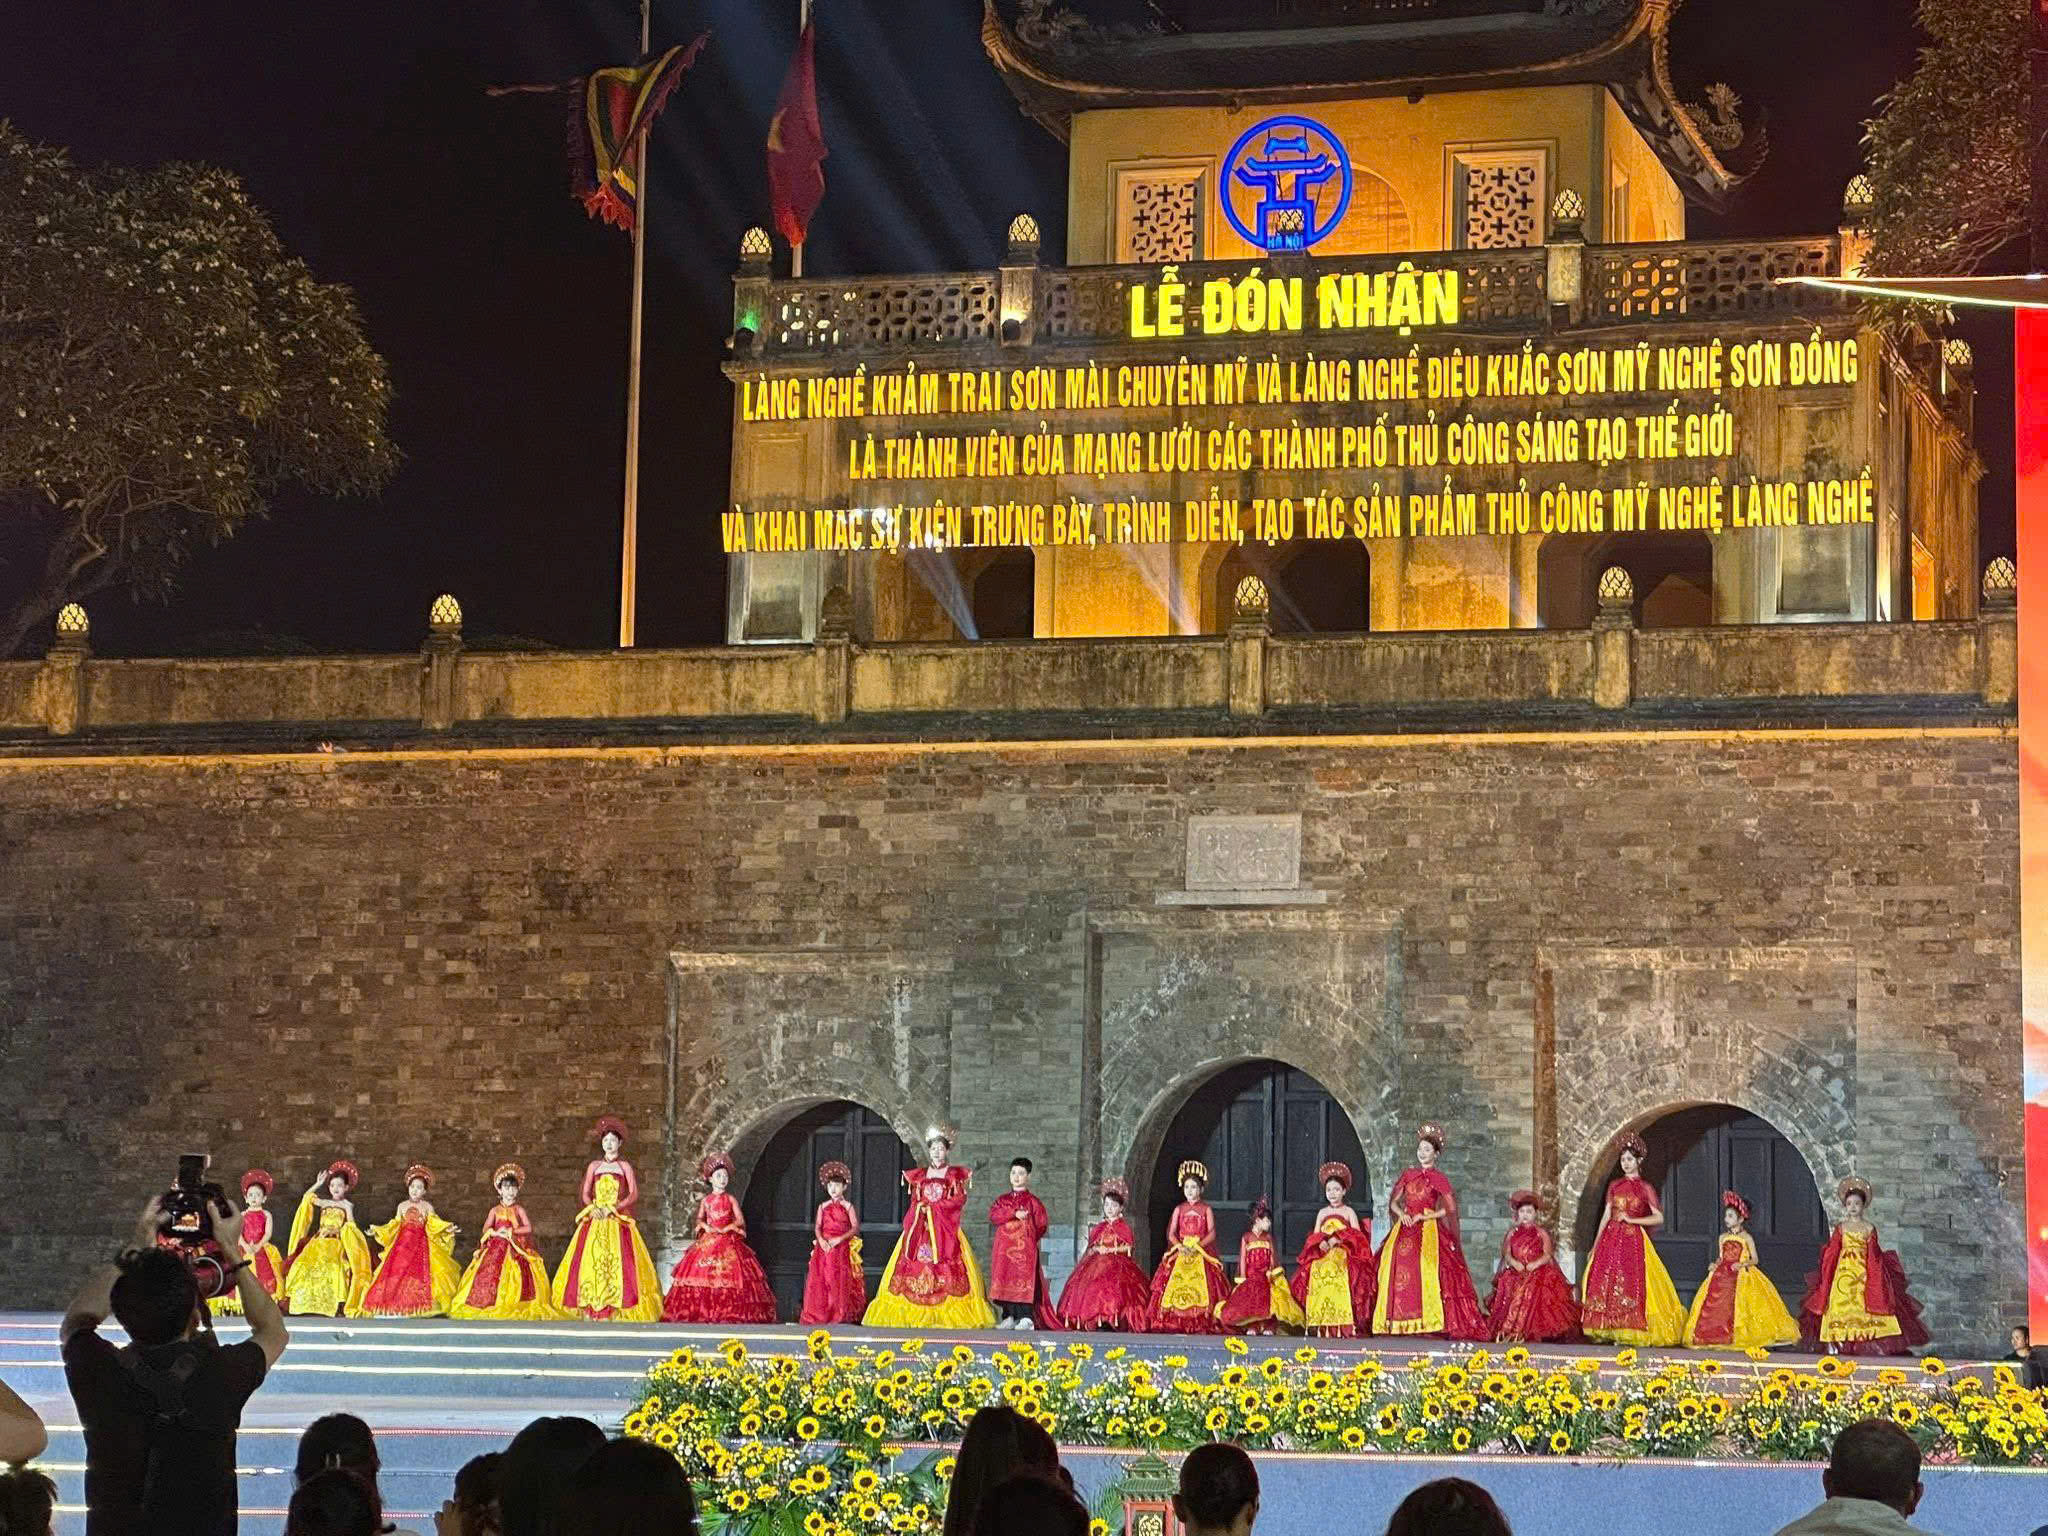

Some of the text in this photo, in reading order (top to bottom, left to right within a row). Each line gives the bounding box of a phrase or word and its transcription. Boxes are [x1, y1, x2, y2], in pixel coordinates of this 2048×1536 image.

[1267, 232, 1282, 249] HÀ
[1132, 262, 1458, 338] LỄ ĐÓN NHẬN
[744, 326, 1857, 420] LÀNG NGHỀ KHẢM TRAI SƠN MÀI CHUYÊN MỸ VÀ LÀNG NGHỀ ĐIÊU KHẮC SƠN MỸ NGHỆ SƠN ĐỒNG
[850, 399, 1732, 479] LÀ THÀNH VIÊN CỦA MẠNG LƯỚI CÁC THÀNH PHỐ THỦ CÔNG SÁNG TẠO THẾ GIỚI
[722, 465, 1873, 556] VÀ KHAI MẠC SỰ KIỆN TRƯNG BÀY, TRÌNH DIỄN, TẠO TÁC SẢN PHẨM THỦ CÔNG MỸ NGHỆ LÀNG NGHỀ
